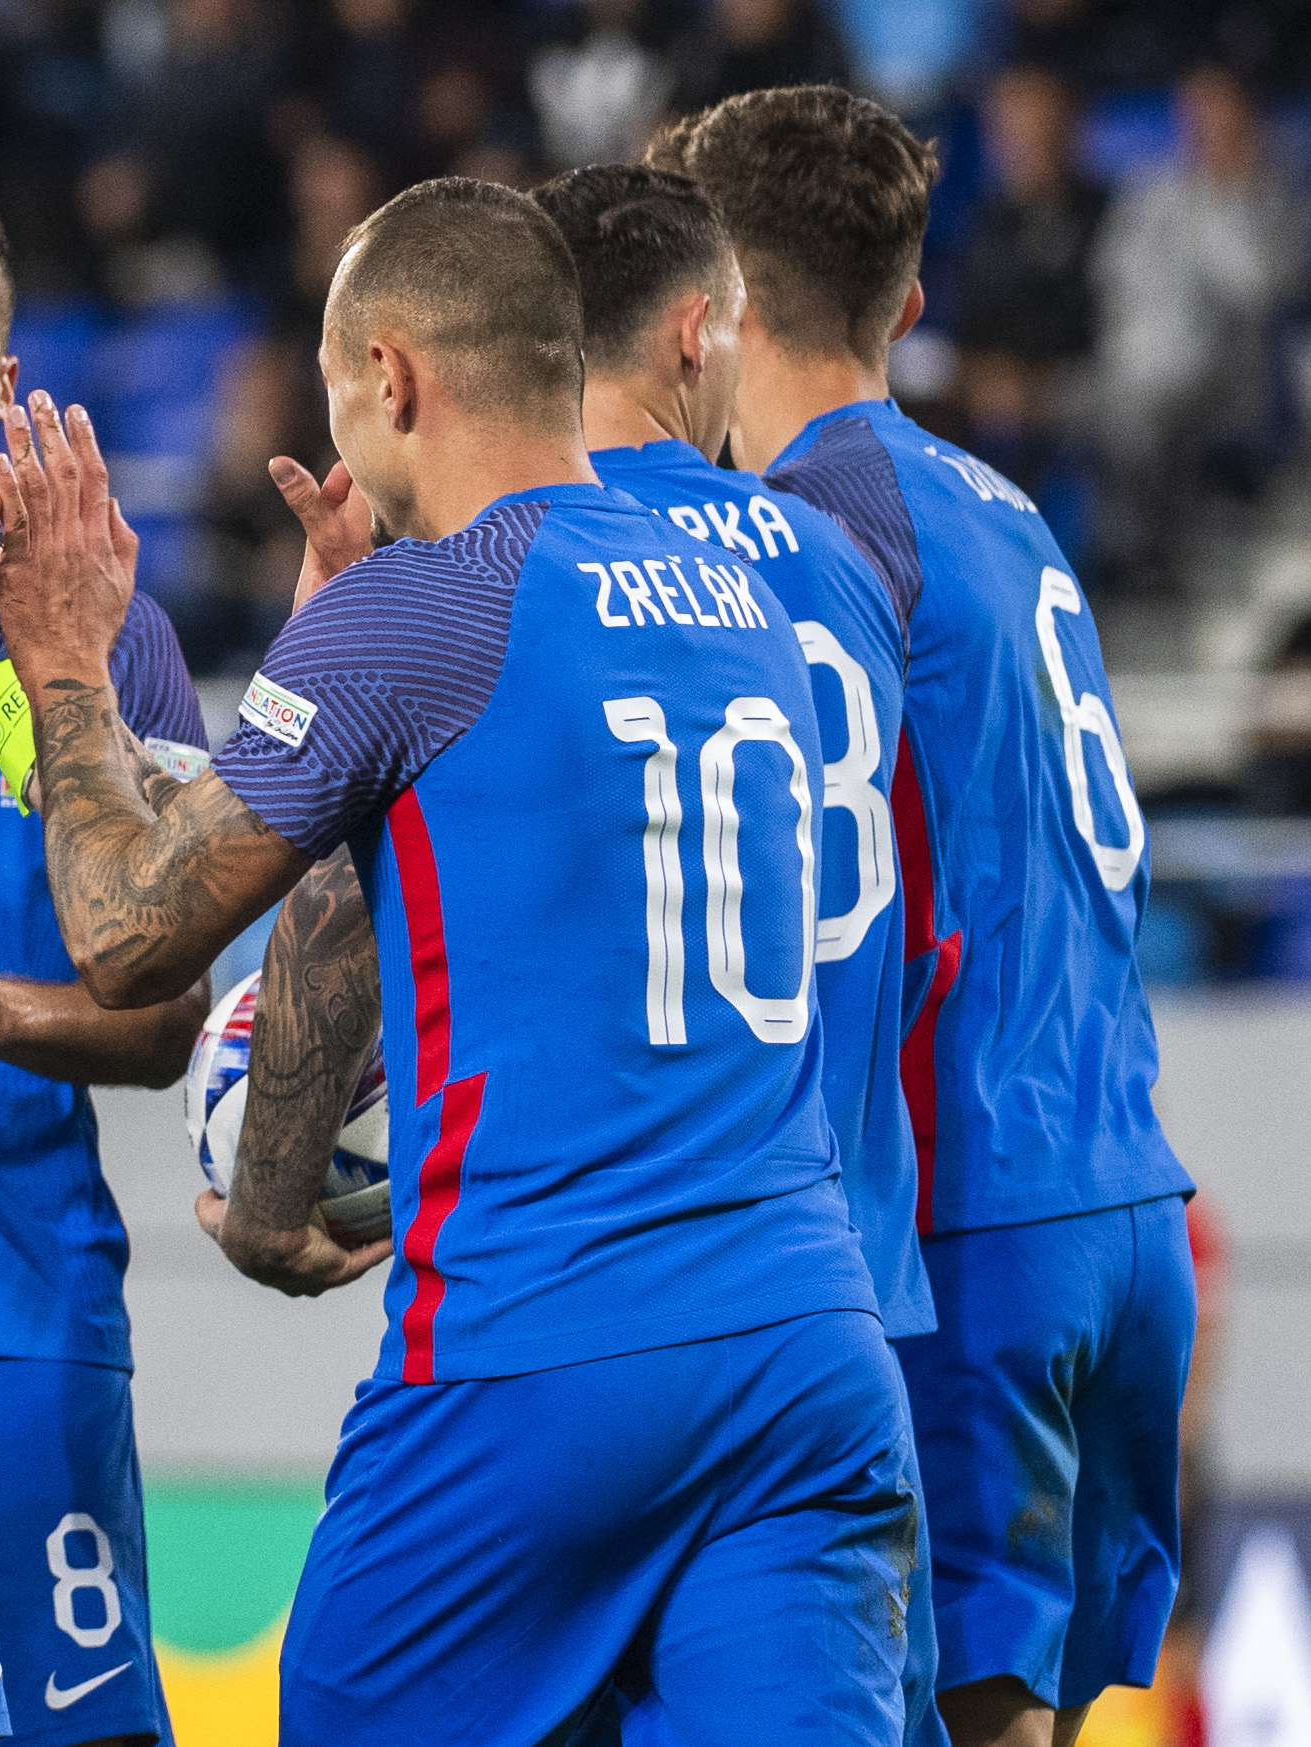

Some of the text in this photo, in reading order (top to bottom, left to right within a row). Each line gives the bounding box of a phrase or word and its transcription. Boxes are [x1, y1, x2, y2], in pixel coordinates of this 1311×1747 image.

[576, 554, 769, 630] ZREĽÁK
[1035, 565, 1145, 892] 6
[602, 696, 815, 1045] 10
[46, 1512, 122, 1648] 8
